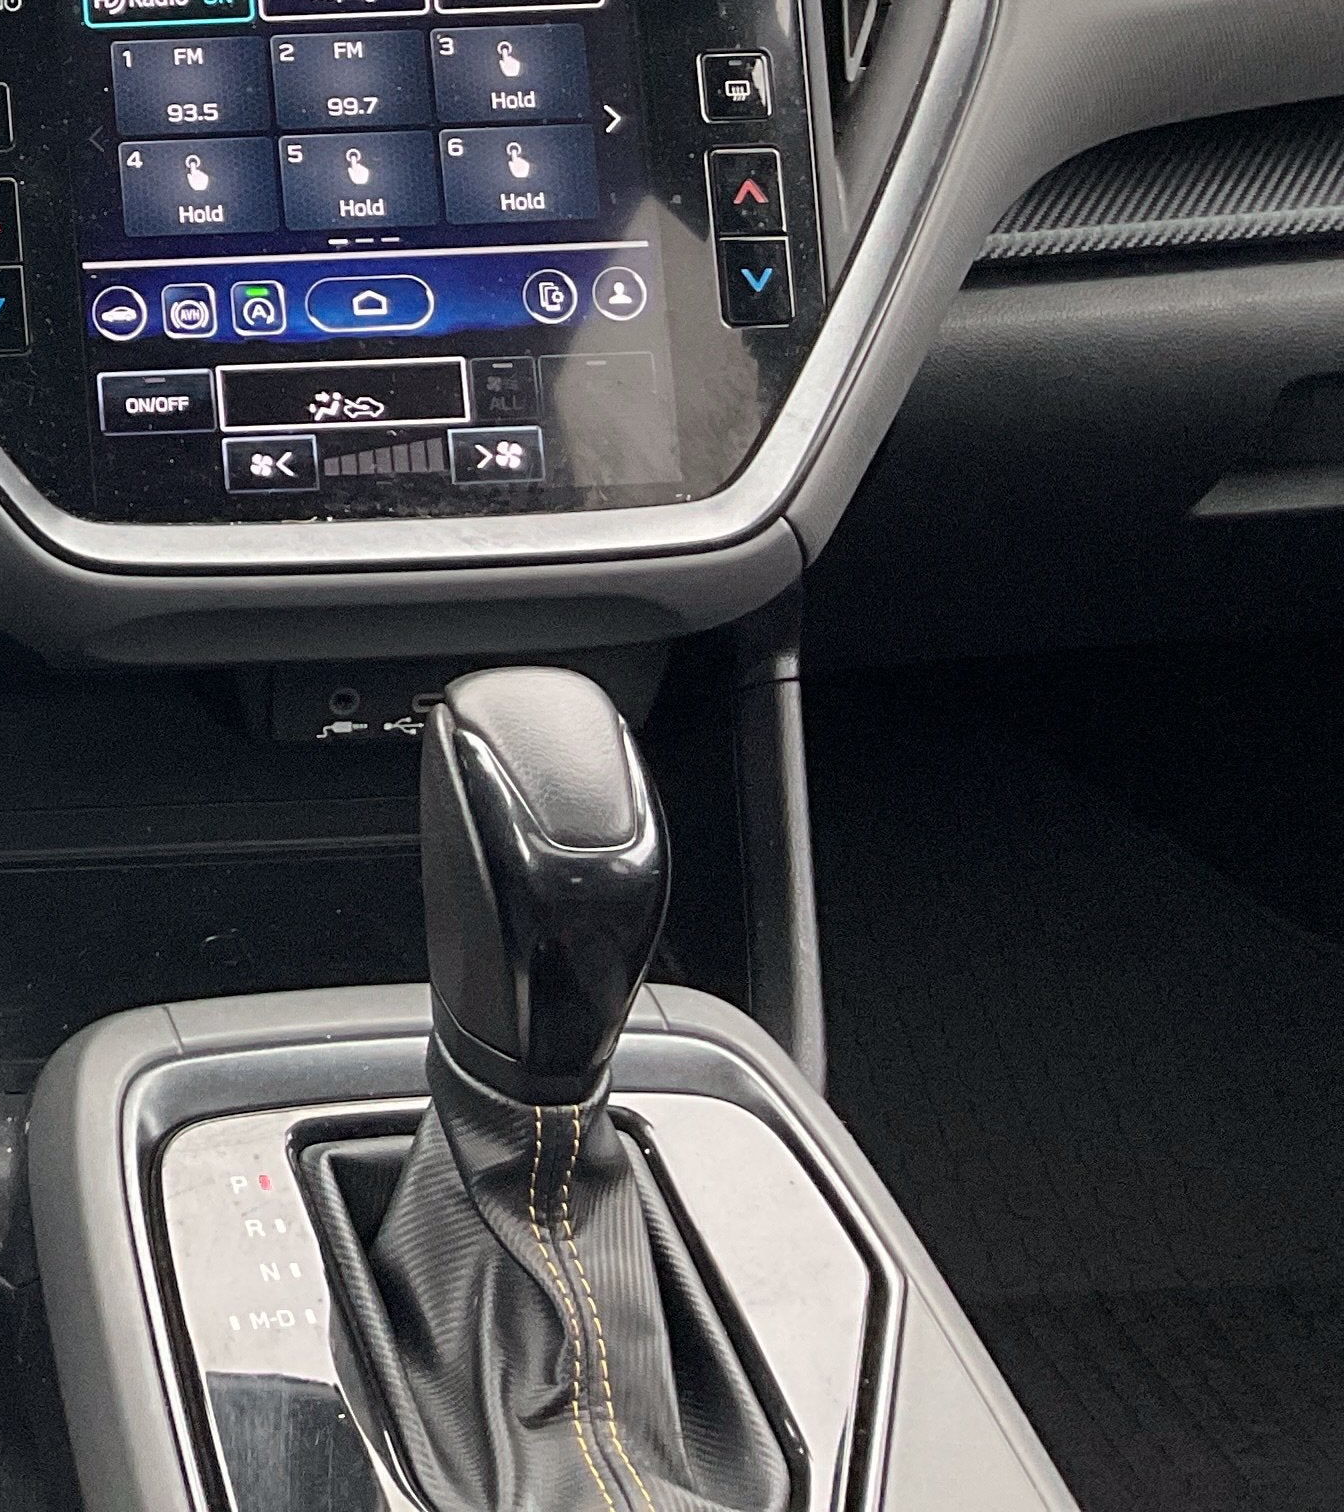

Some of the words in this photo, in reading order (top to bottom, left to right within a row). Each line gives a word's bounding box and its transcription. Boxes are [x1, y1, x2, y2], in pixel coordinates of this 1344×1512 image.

[279, 43, 295, 62] 2
[333, 42, 364, 60] FM
[438, 37, 454, 56] 3
[121, 50, 132, 68] 1
[173, 48, 204, 66] FM
[326, 96, 378, 116] 99.7
[490, 90, 536, 110] Hold
[166, 102, 218, 123] 93.5
[286, 144, 303, 164] 5
[447, 138, 464, 157] 6
[126, 151, 143, 169] 4
[338, 197, 385, 217] Hold
[500, 191, 546, 211] Hold
[178, 203, 224, 224] Hold
[125, 395, 190, 415] ON/OFF
[230, 1175, 248, 1195] P
[245, 1219, 266, 1237] R
[259, 1262, 281, 1282] N
